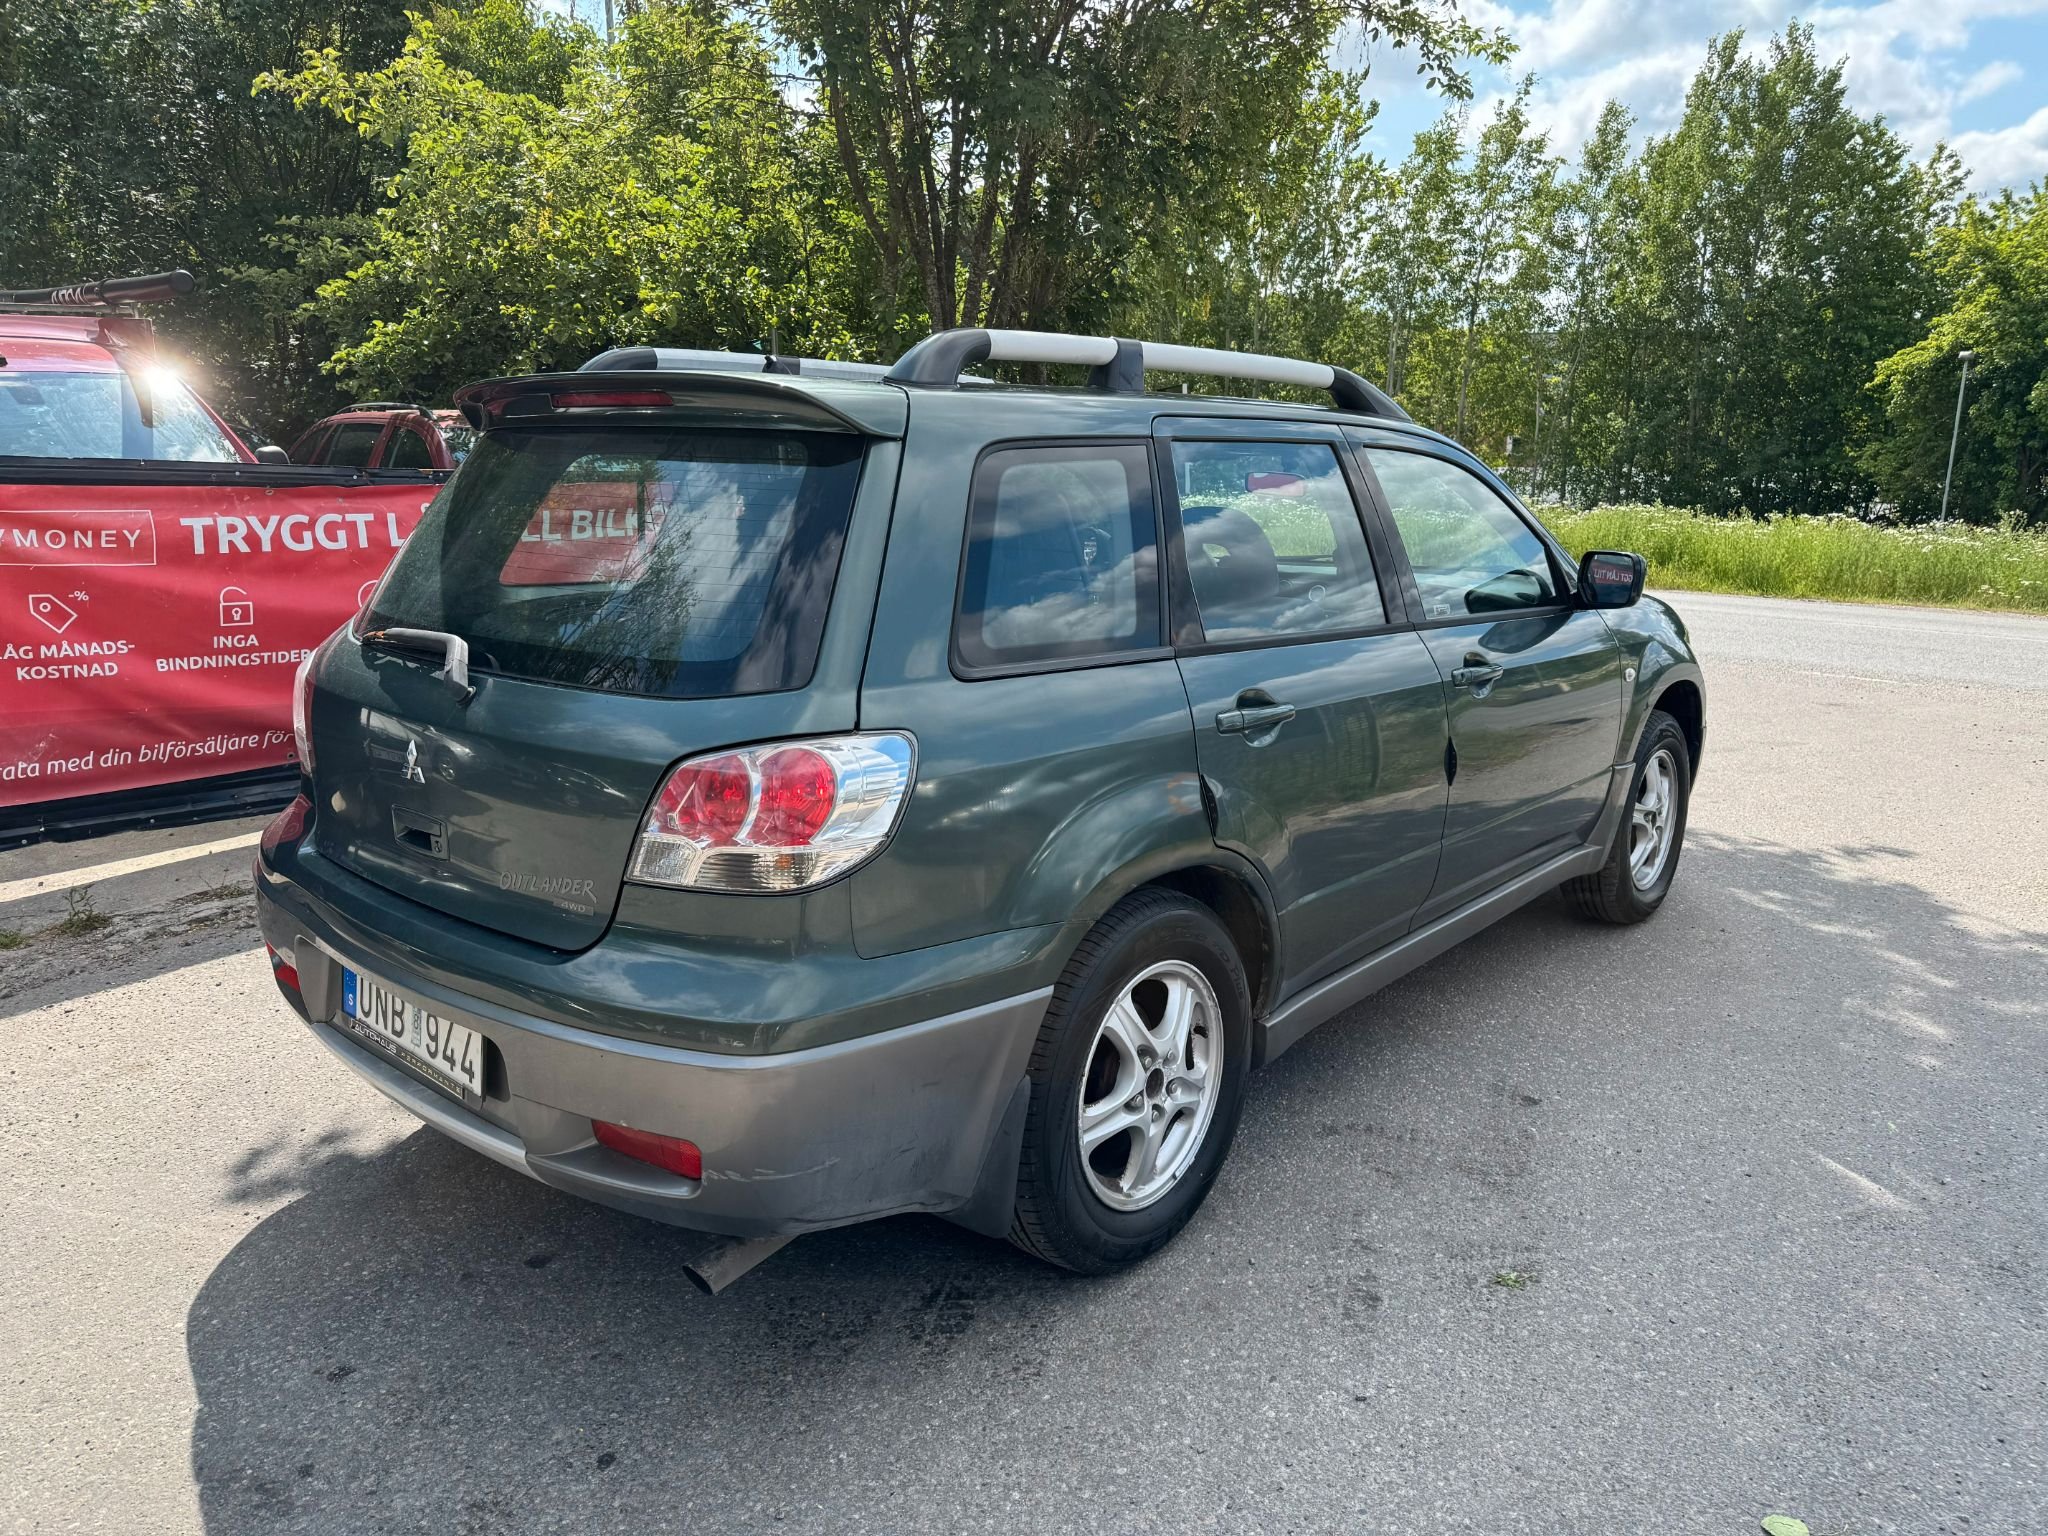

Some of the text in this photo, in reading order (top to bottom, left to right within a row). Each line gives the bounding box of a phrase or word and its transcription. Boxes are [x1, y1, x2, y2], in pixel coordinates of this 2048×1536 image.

[179, 502, 431, 555] TRYGGT L
[0, 640, 136, 660] ÅG MÅNADS-
[213, 634, 260, 649] INGA
[16, 662, 118, 681] KOSTNAD
[156, 648, 311, 672] BINDNINGSTIDER
[47, 750, 94, 775] med
[100, 748, 132, 768] din
[138, 734, 260, 764] bilförsäljare
[262, 730, 294, 749] för
[500, 871, 597, 904] OUTLANDER
[561, 901, 587, 913] 4WD
[348, 993, 355, 1006] S
[360, 977, 405, 1038] UNB
[425, 1012, 475, 1084] 944
[354, 1022, 397, 1053] AUTOHAUS
